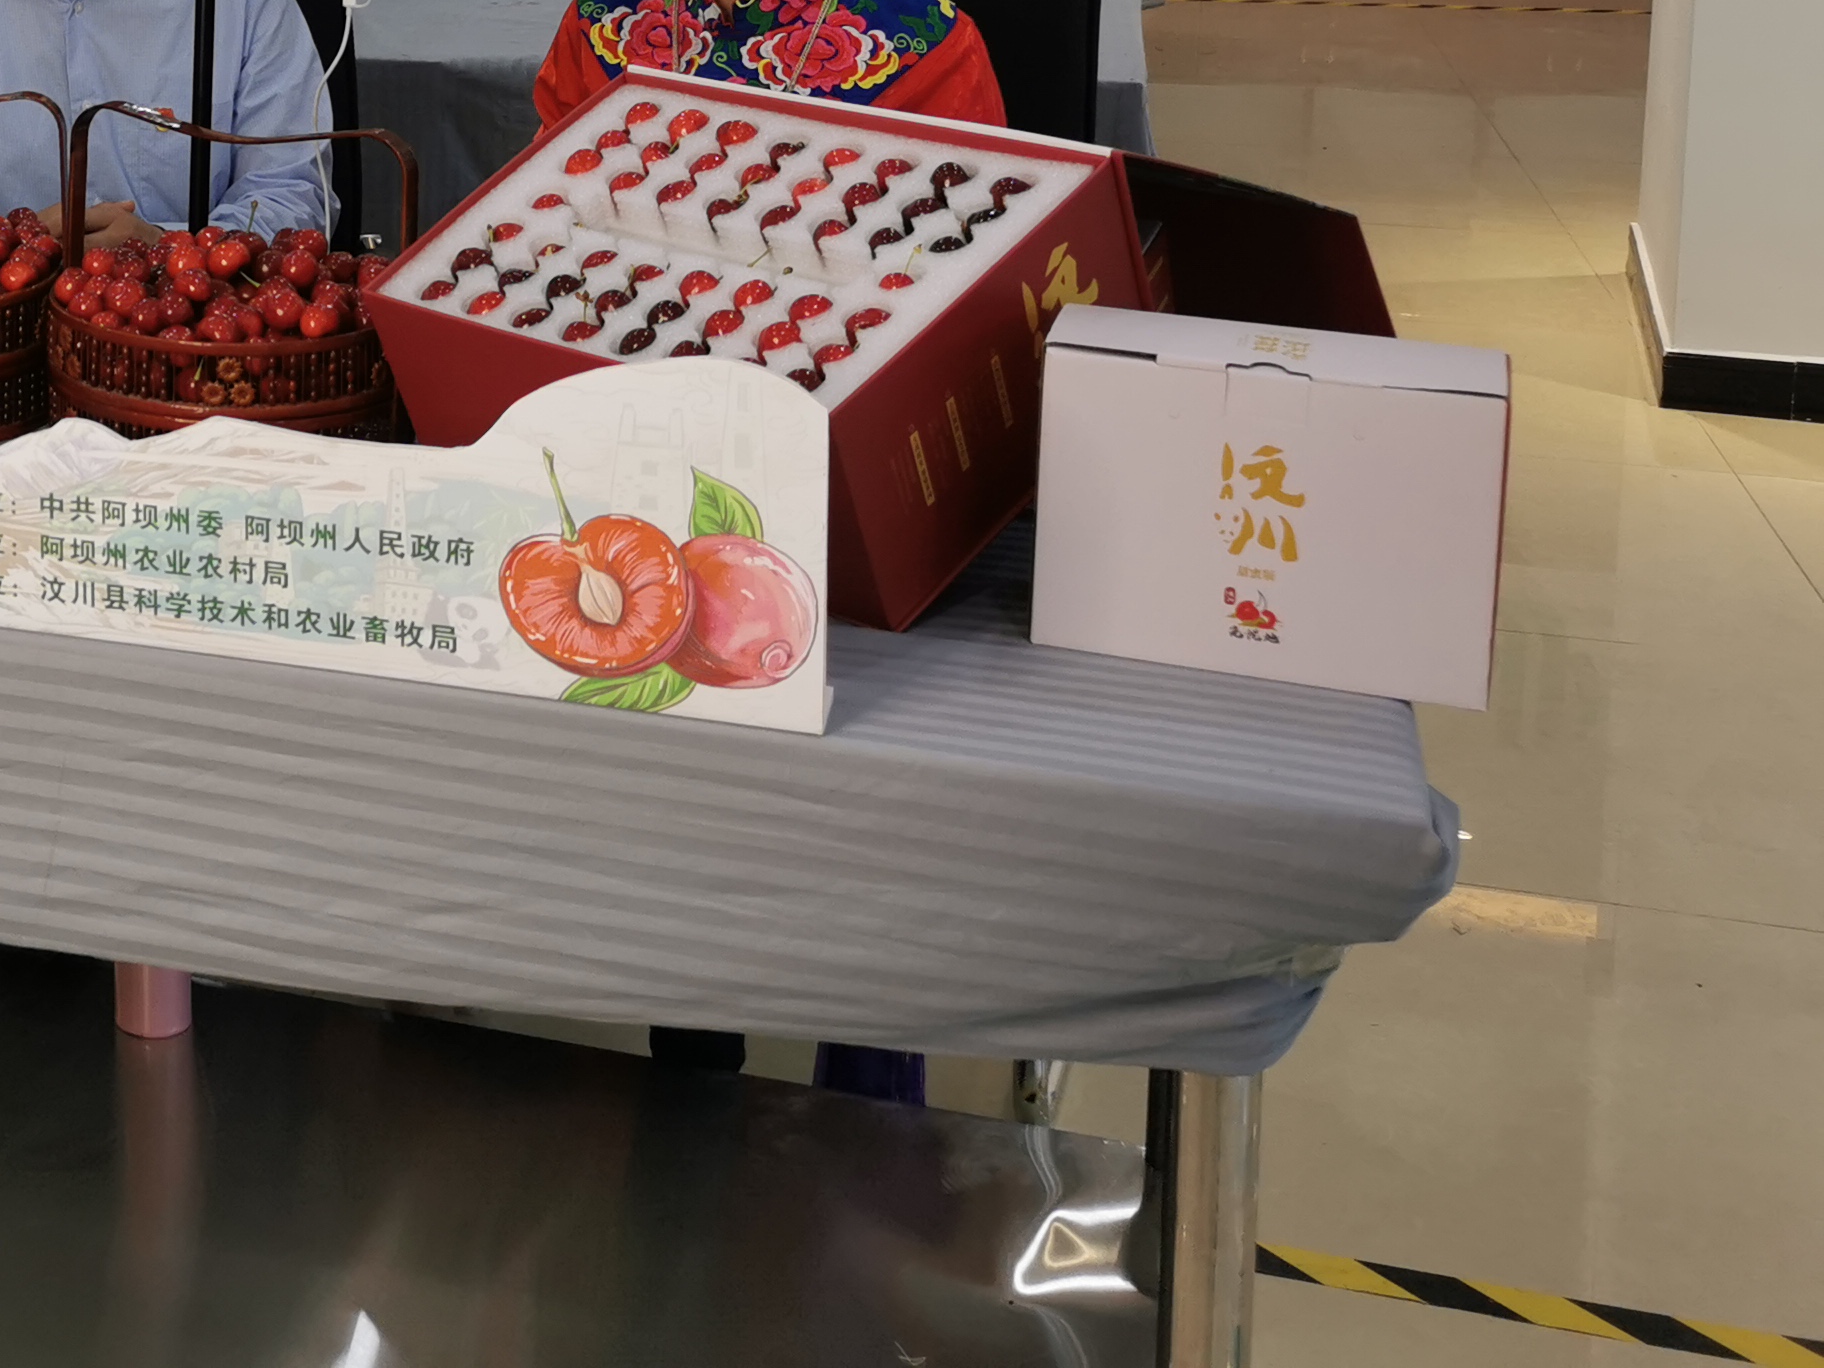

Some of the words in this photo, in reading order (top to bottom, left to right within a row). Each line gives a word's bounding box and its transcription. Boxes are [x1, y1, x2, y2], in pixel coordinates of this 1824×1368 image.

[244, 514, 476, 568] 阿坝州人民政府
